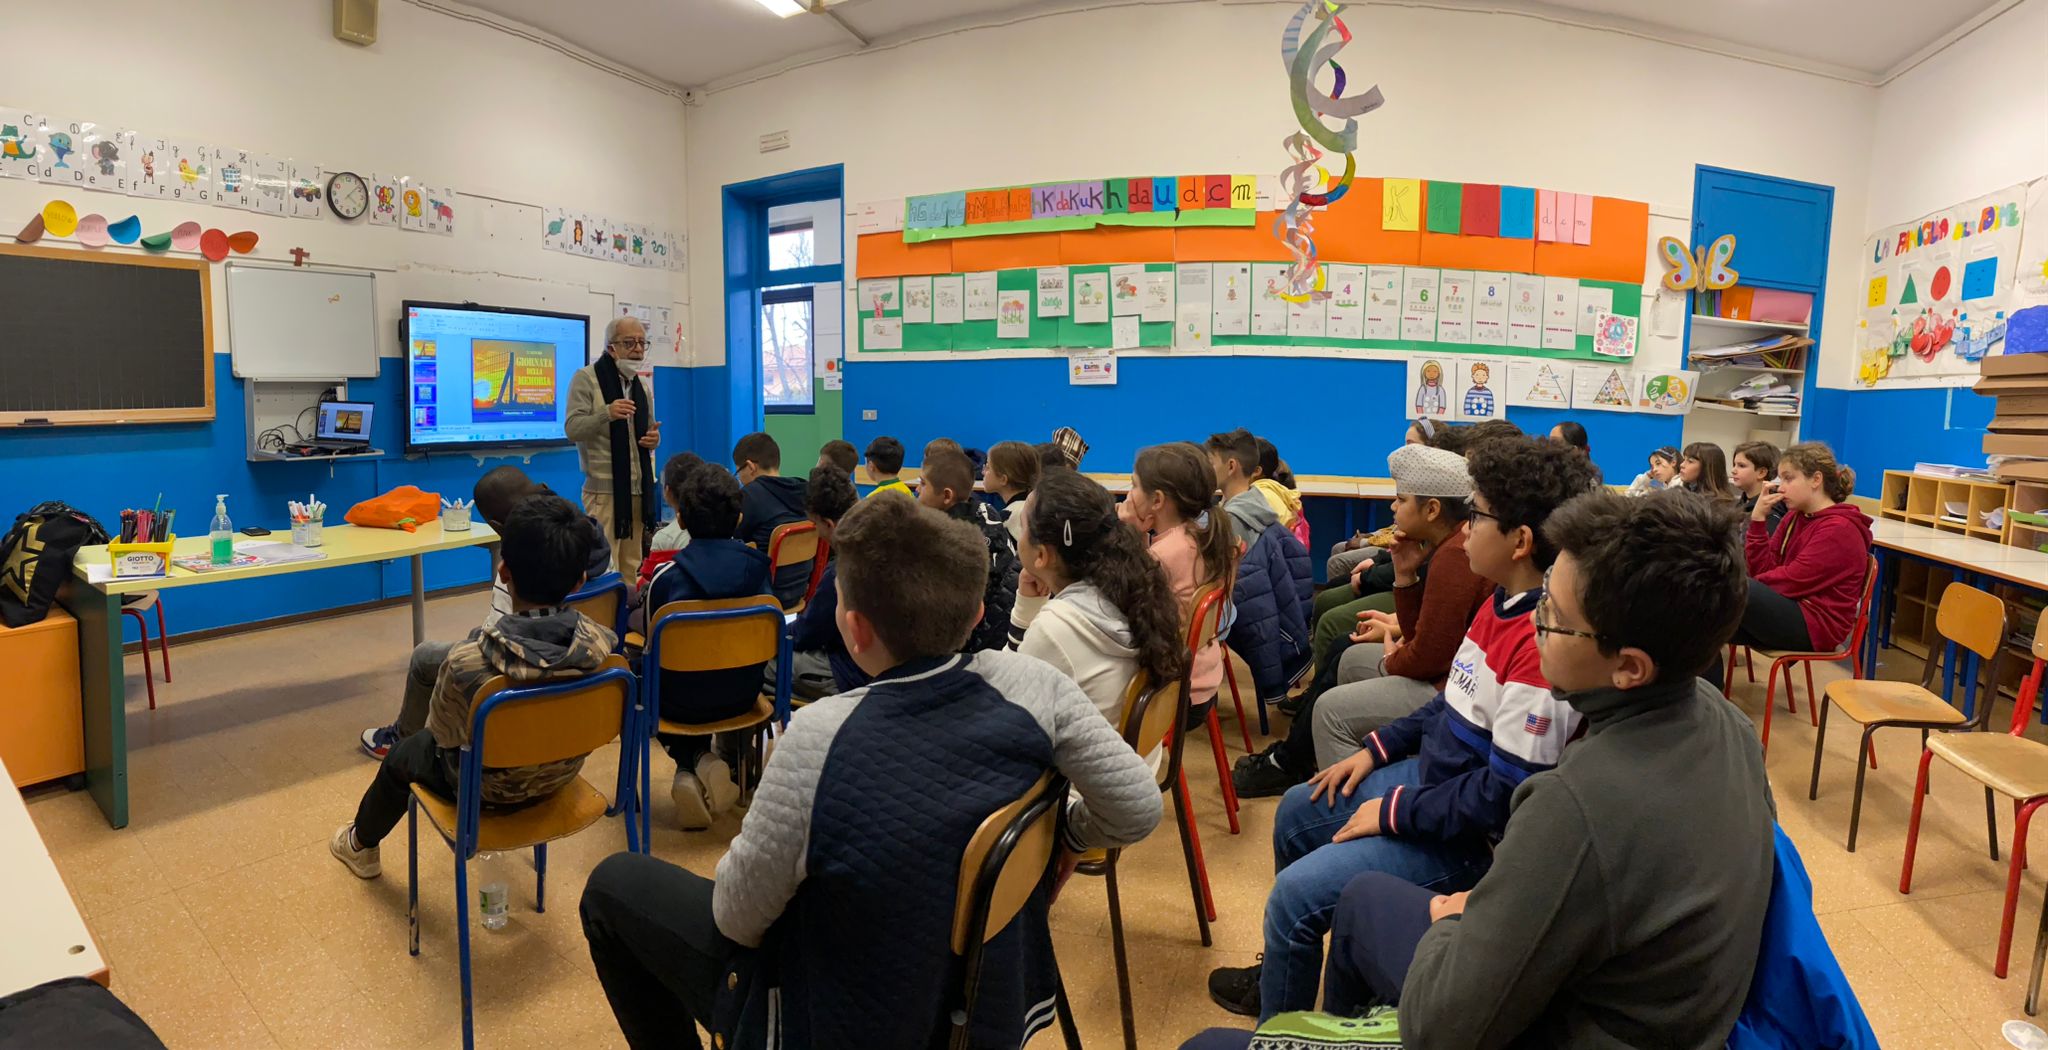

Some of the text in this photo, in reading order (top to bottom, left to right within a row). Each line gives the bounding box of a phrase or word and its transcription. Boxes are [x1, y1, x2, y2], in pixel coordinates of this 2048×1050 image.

[27, 164, 36, 176] C
[44, 167, 84, 182] d D
[89, 175, 125, 189] e E
[133, 180, 166, 194] f F
[174, 188, 208, 200] g G
[216, 192, 248, 206] h H
[1106, 180, 1123, 210] h
[1183, 178, 1199, 202] d
[1232, 184, 1250, 200] m
[1874, 238, 1890, 264] LA
[1342, 284, 1351, 294] 4
[1451, 286, 1458, 295] 7
[1488, 286, 1496, 297] 8
[1420, 289, 1429, 302] 6
[1522, 291, 1530, 302] 9
[1556, 294, 1564, 302] 10
[516, 358, 552, 368] GIORNATA
[519, 376, 551, 386] MEMORIA
